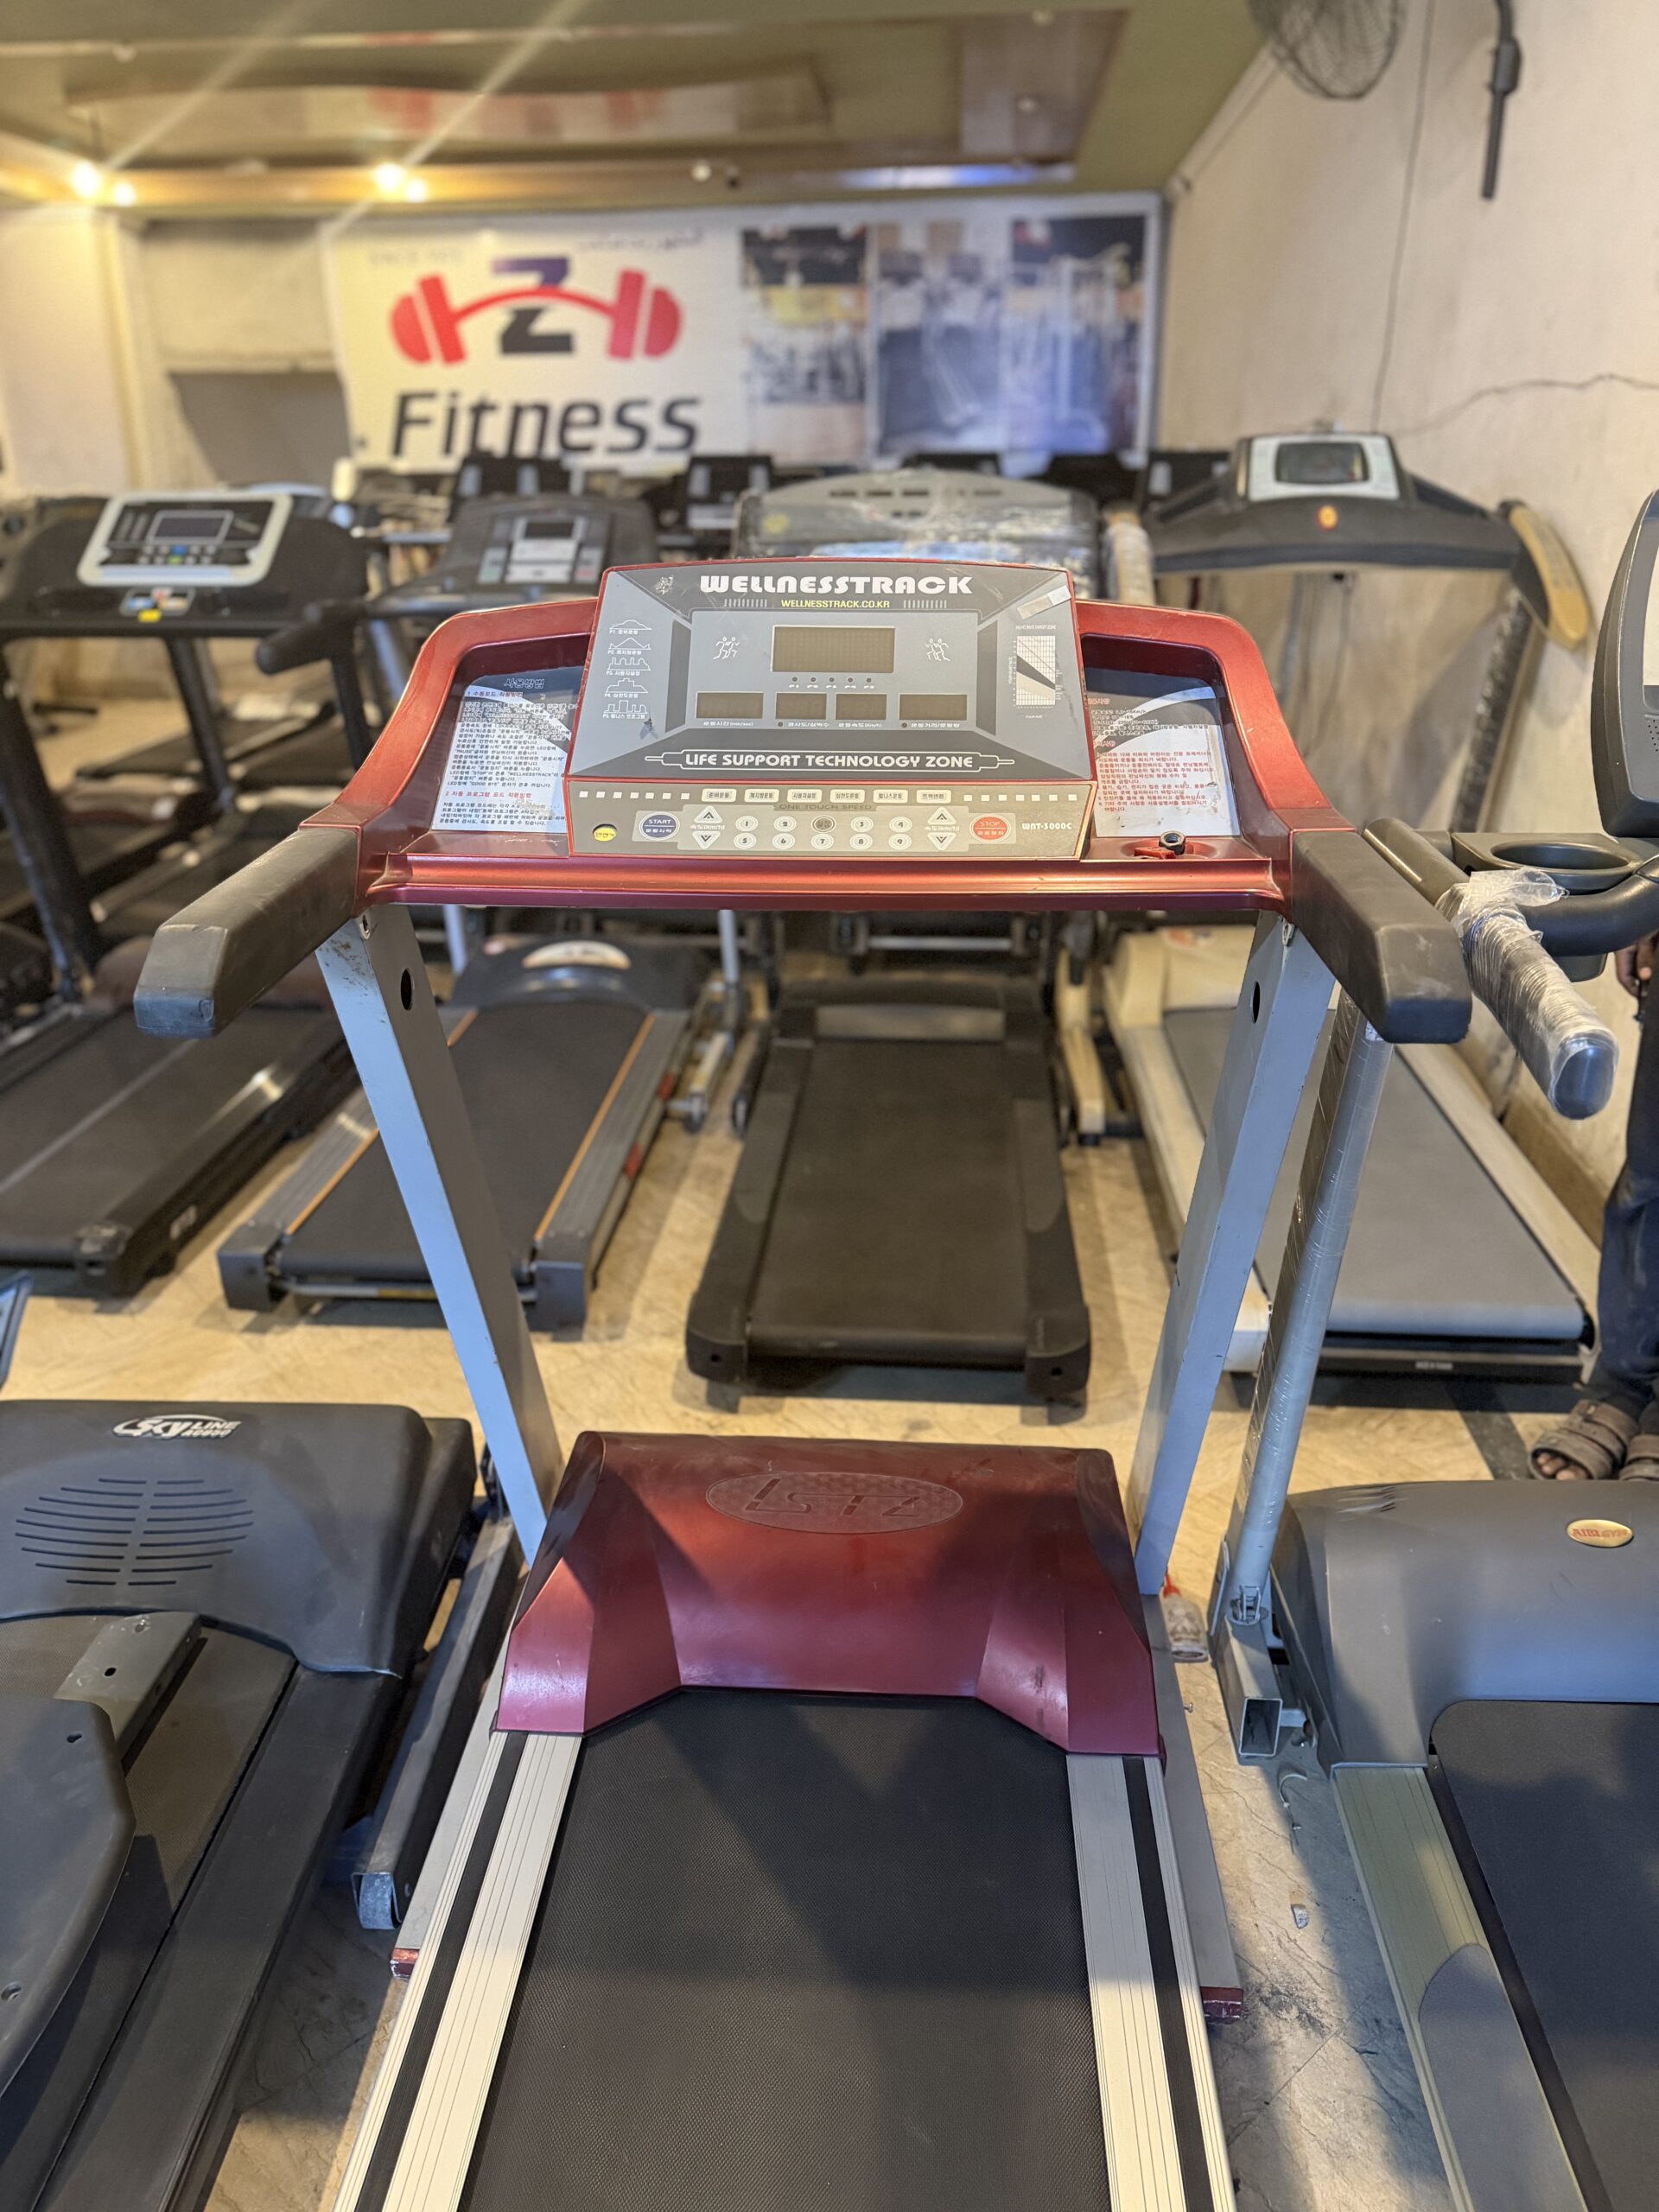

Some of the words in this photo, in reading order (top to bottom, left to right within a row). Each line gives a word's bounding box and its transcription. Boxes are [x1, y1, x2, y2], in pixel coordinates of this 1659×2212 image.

[391, 391, 702, 457] Fitness
[700, 575, 973, 594] WELLNESSTRACK
[781, 600, 890, 608] WELLNESSTRACK.CO.KR
[685, 753, 717, 766] LIFE
[722, 754, 800, 766] SUPPORT
[805, 755, 920, 767] TECHNOLOGY
[925, 756, 973, 767] ZONE
